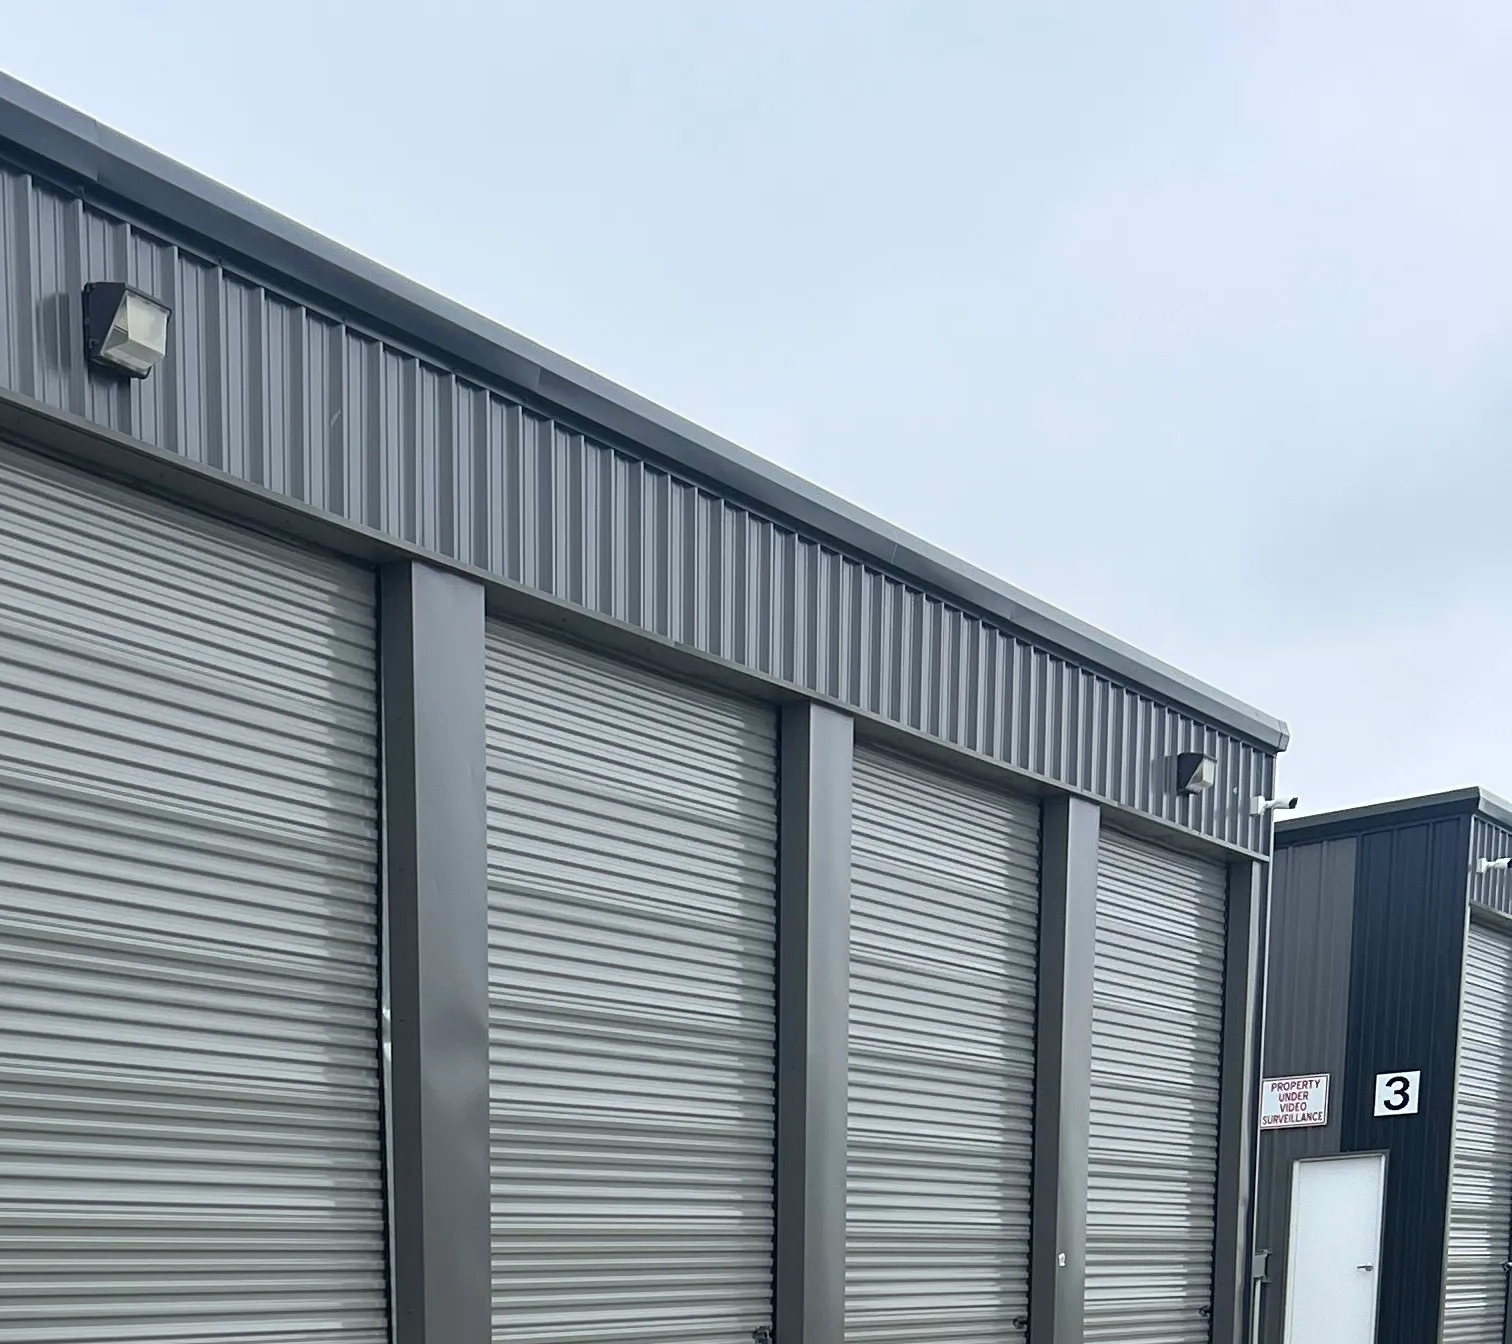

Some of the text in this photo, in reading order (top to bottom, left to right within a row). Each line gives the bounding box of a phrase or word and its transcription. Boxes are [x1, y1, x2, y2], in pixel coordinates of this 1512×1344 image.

[1270, 1079, 1321, 1092] PROPERTY
[1278, 1091, 1309, 1102] UNDER
[1383, 1076, 1410, 1111] 3
[1279, 1102, 1307, 1112] VIDEO
[1262, 1111, 1323, 1125] SURVEILLANCE
